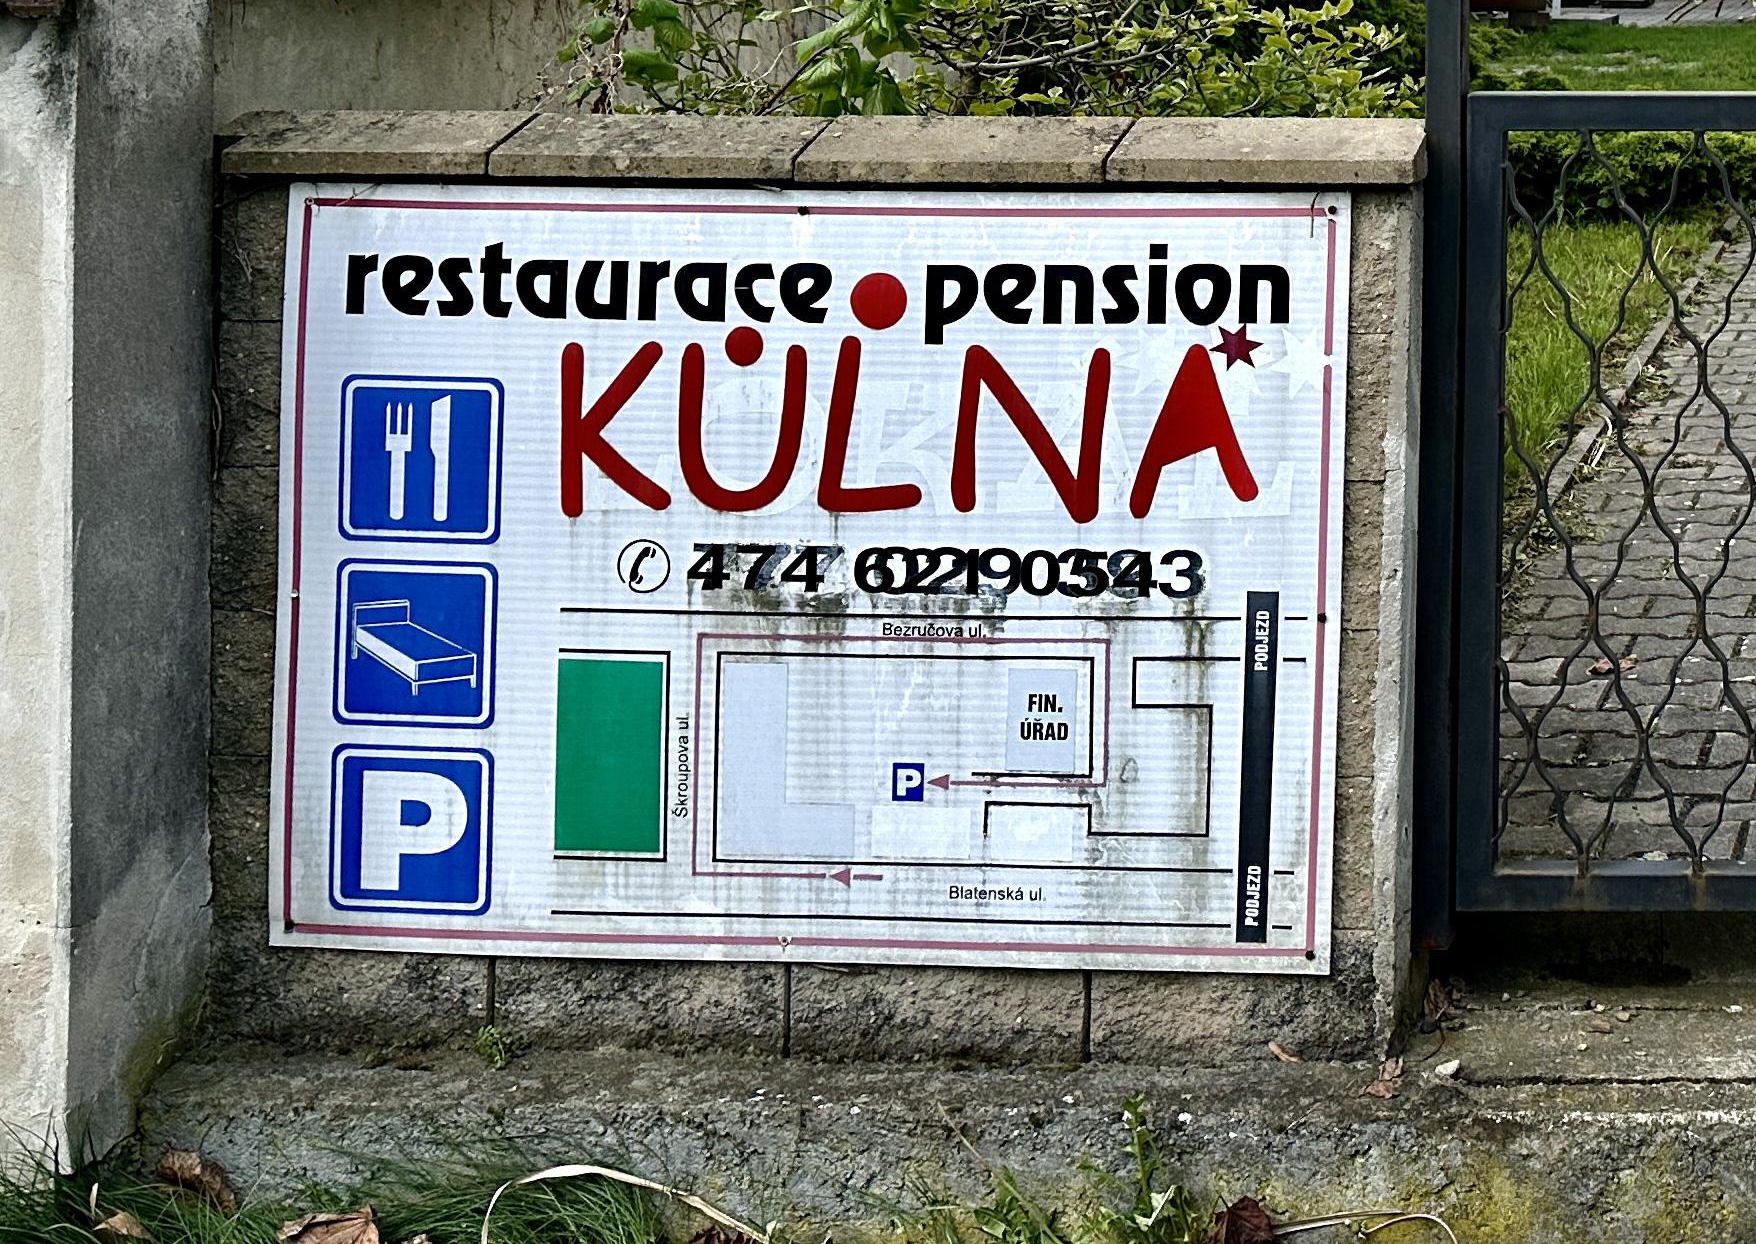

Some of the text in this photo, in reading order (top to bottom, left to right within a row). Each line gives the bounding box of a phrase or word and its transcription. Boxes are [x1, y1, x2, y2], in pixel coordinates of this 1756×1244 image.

[345, 241, 1291, 346] restaurace pension
[882, 622, 987, 639] Bezručova ul.
[1253, 610, 1270, 672] PODJEZD
[1020, 717, 1069, 741] ÚŘAD
[1027, 693, 1063, 713] FIN.
[671, 712, 691, 819] Škroupova ul.
[361, 770, 468, 891] P
[949, 885, 1047, 902] Blatenská ul.
[1244, 865, 1262, 927] PODJEZD
